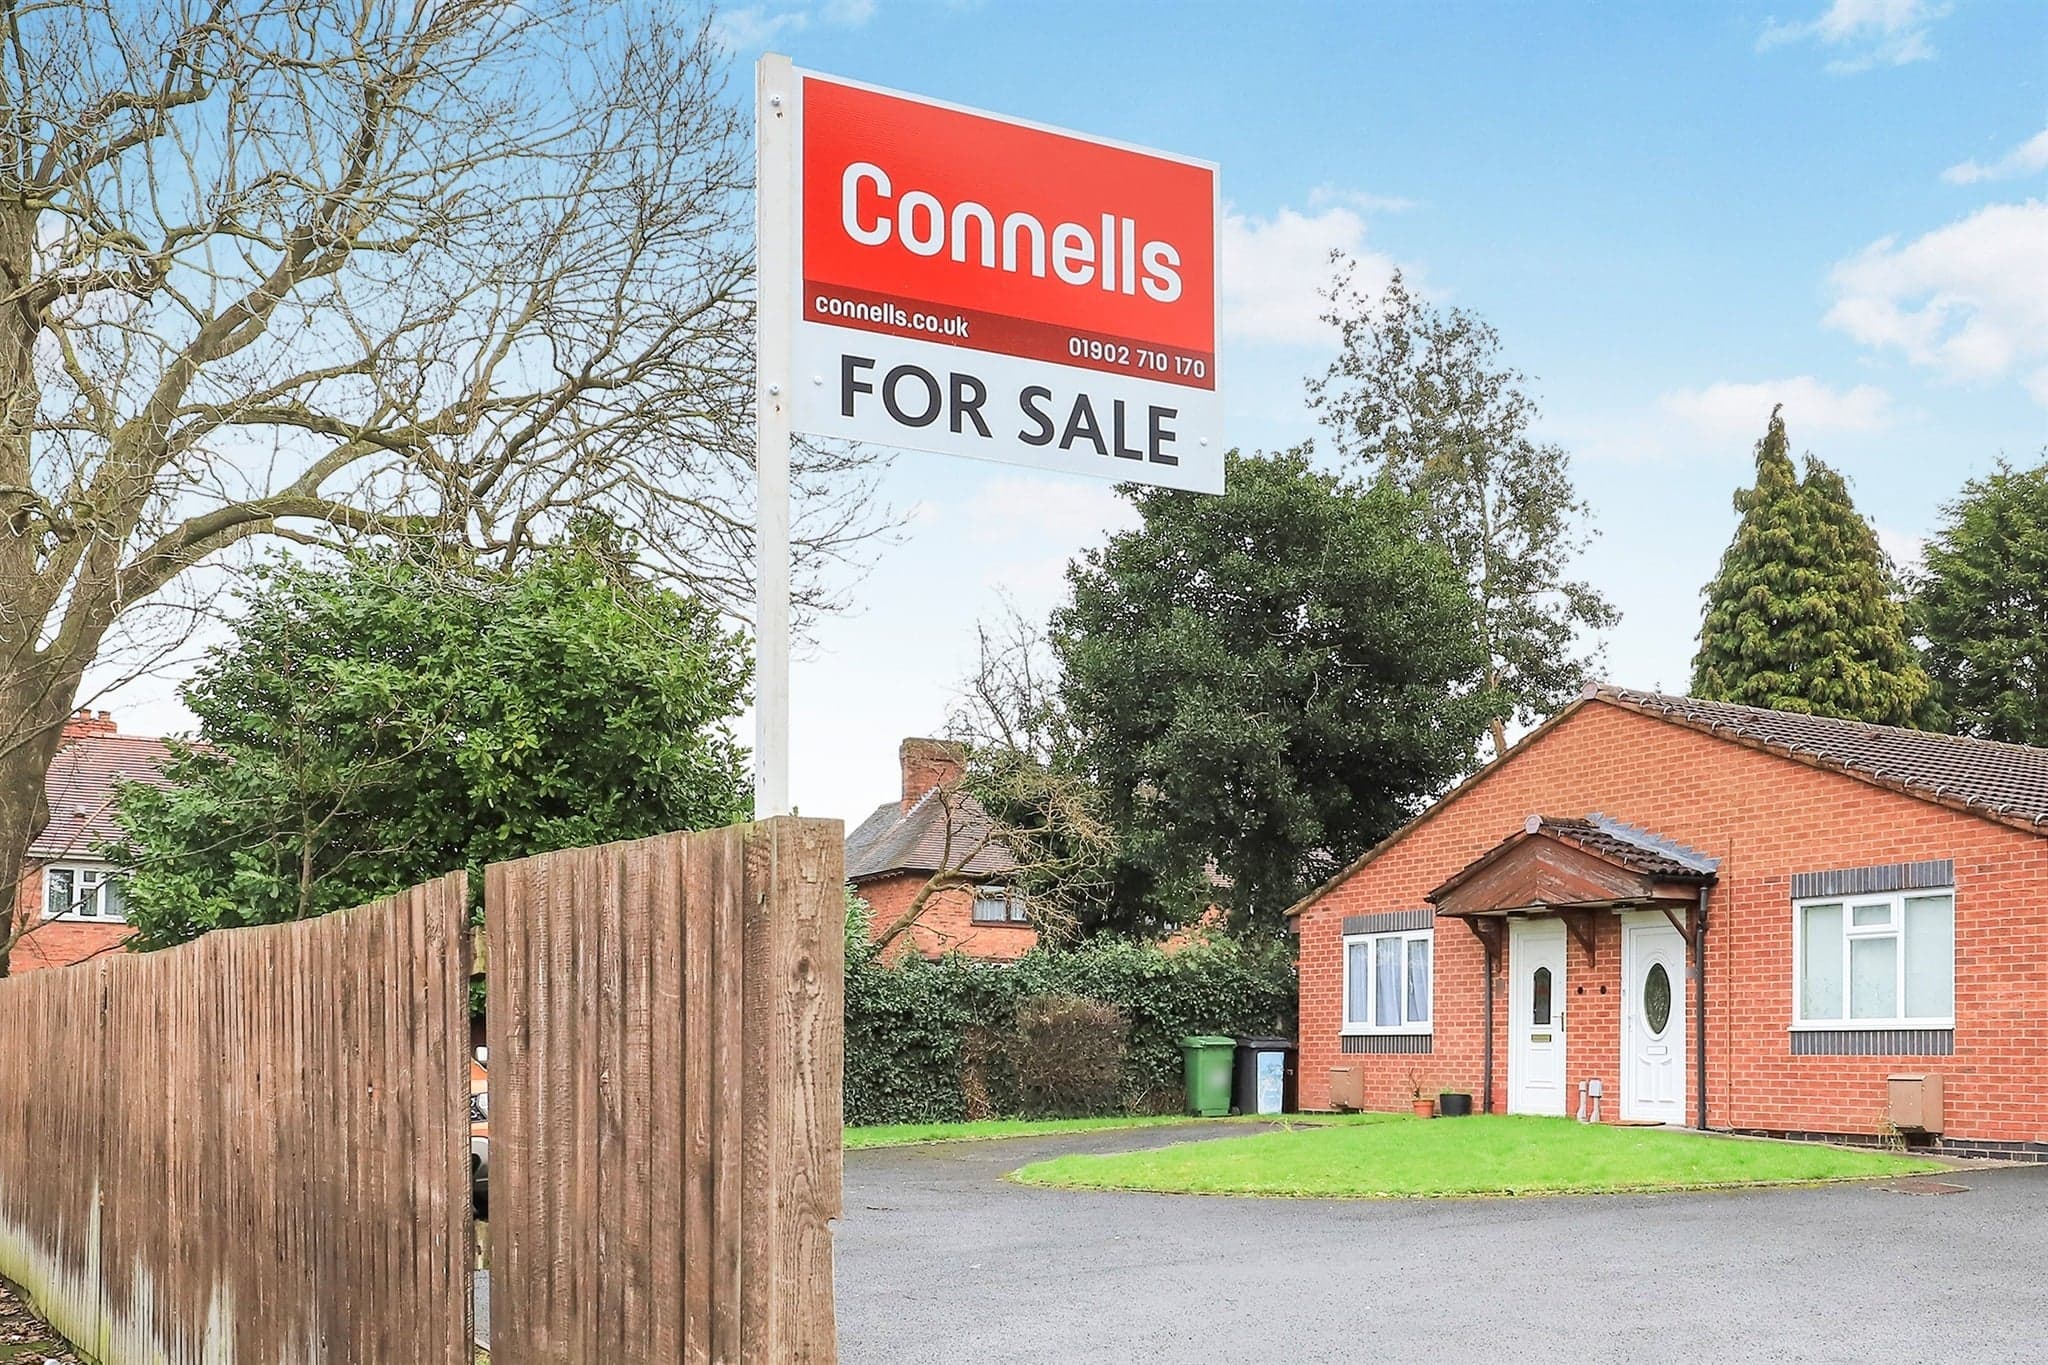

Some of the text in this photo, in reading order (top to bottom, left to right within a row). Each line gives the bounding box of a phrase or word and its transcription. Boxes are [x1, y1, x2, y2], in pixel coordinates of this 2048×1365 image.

[842, 162, 1182, 303] Connells
[815, 295, 969, 338] connells.co.uk
[1069, 337, 1206, 379] 01902 710 170
[841, 354, 1179, 466] FOR SALE
